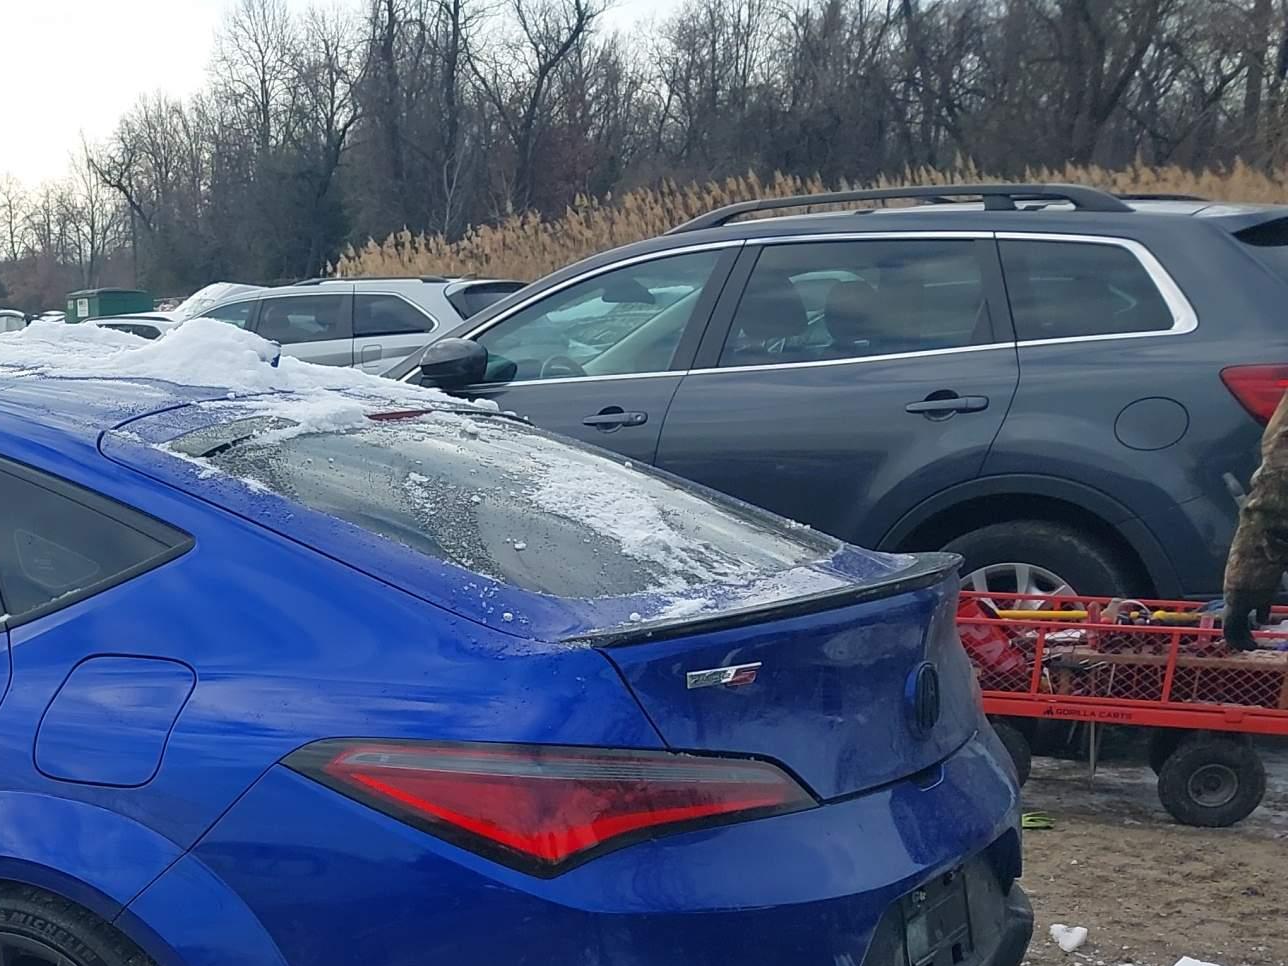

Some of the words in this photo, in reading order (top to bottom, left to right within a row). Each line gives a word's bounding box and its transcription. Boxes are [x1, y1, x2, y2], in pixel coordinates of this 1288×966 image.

[1055, 708, 1097, 717] GORILLA
[1098, 711, 1132, 720] CARTS
[9, 911, 98, 963] MICHELIN
